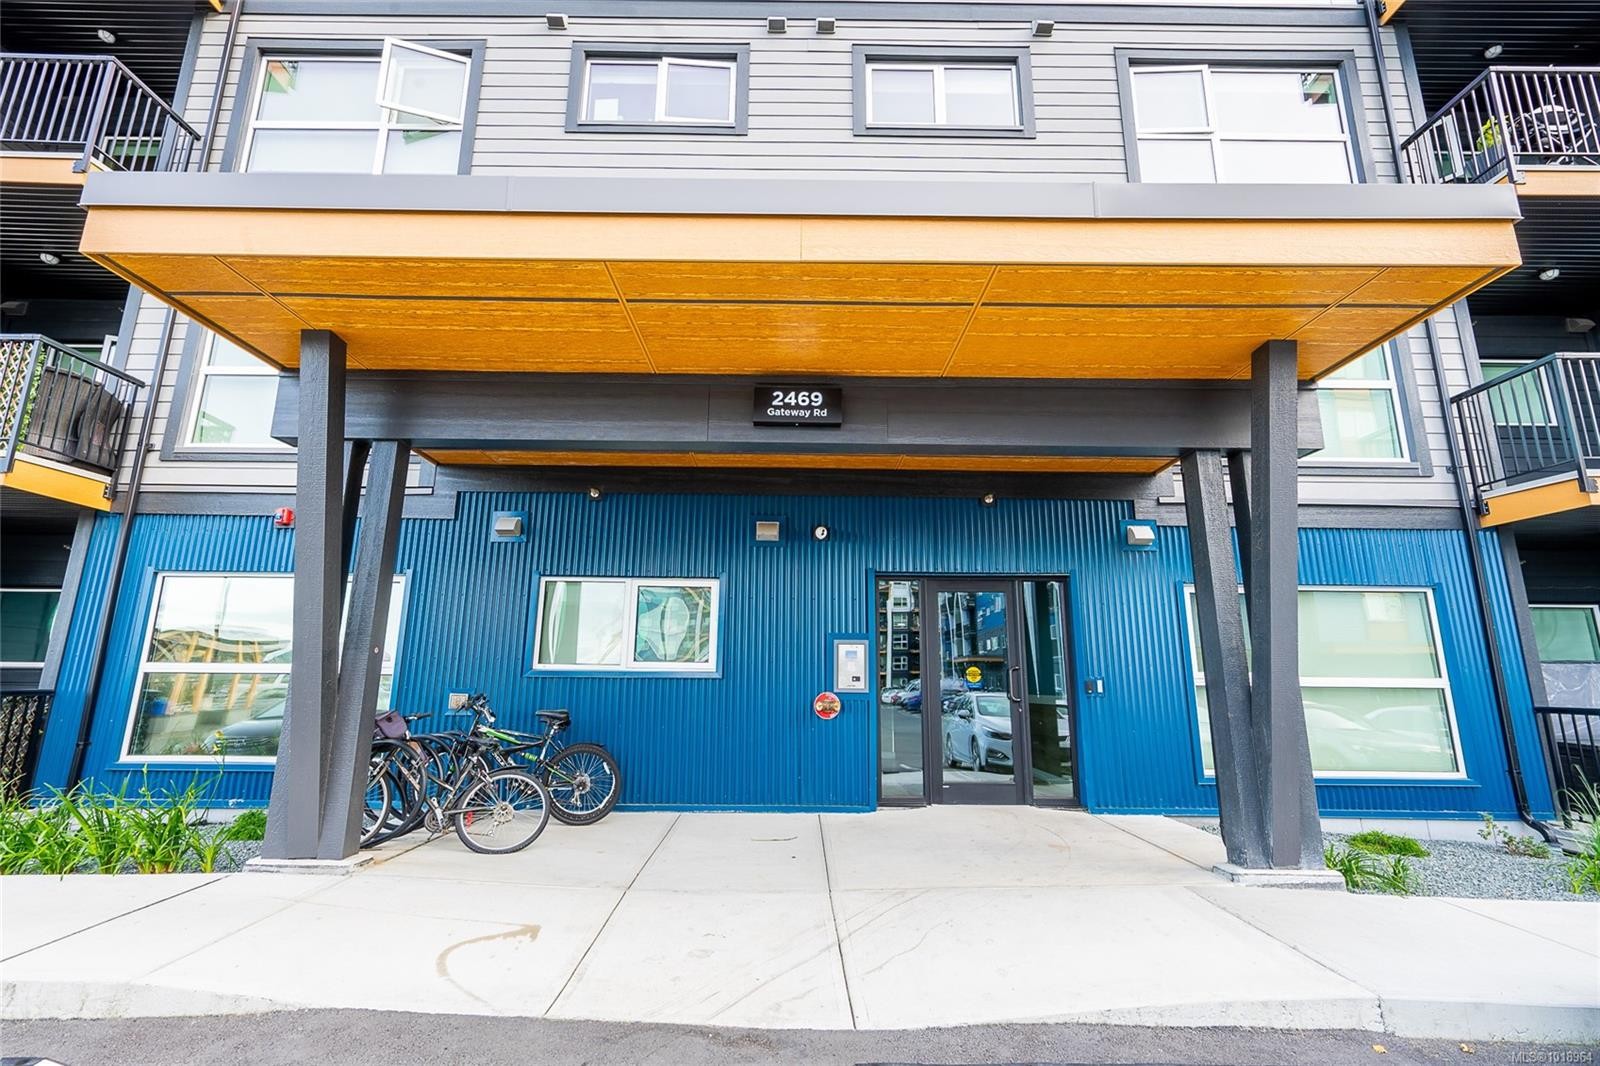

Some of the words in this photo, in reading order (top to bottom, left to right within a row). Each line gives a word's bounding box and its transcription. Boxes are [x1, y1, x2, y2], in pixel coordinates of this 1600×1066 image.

[772, 391, 823, 406] 2469
[767, 408, 811, 418] Gateway
[813, 408, 827, 417] Rd
